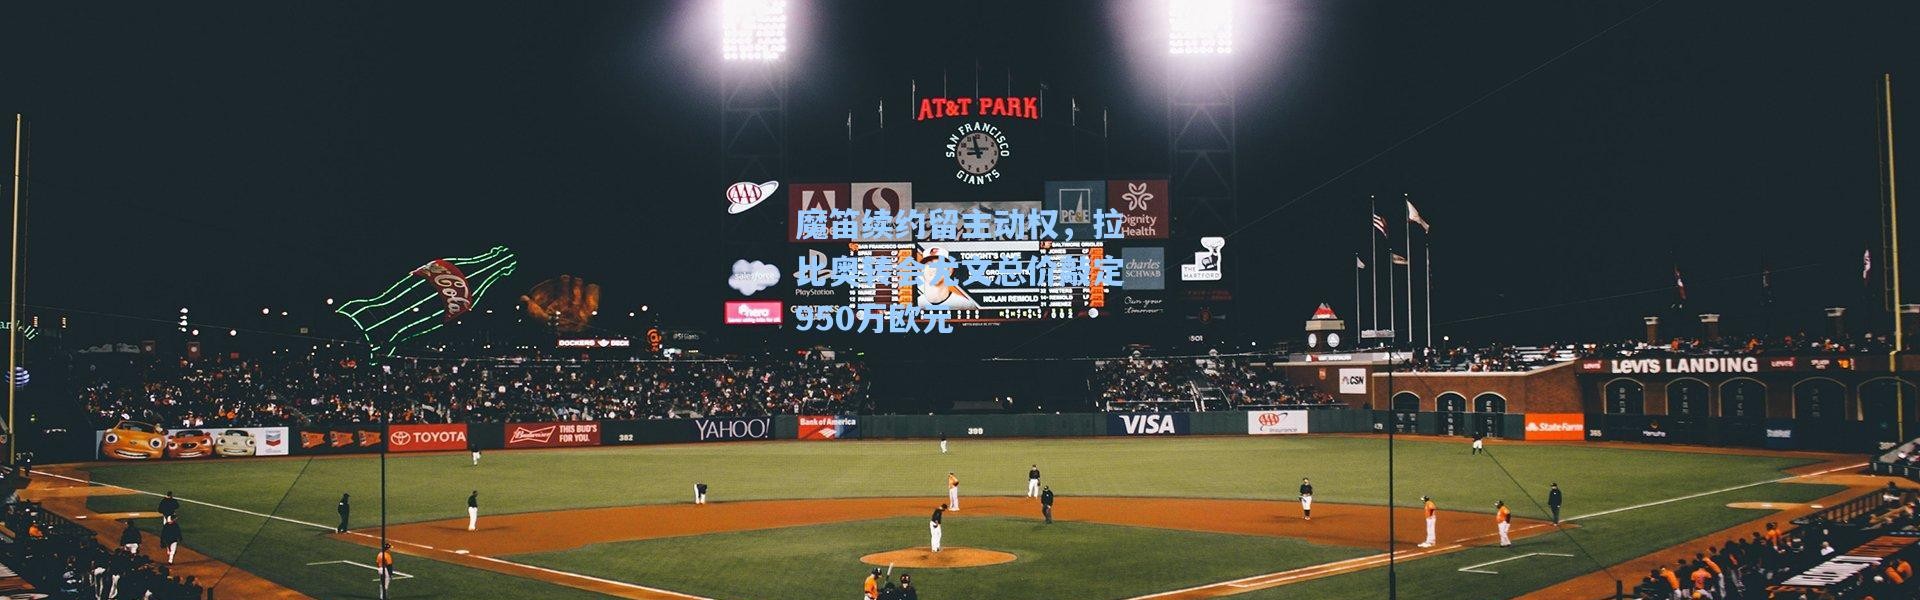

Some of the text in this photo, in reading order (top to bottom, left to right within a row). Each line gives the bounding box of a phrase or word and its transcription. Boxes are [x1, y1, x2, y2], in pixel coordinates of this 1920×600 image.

[917, 97, 1038, 120] AT&T PARK
[945, 121, 1010, 158] SAN FRANCISCO
[956, 169, 1000, 185] GIANTS
[1120, 214, 1157, 226] Dignity
[1121, 226, 1156, 236] Health
[1126, 259, 1160, 270] charles
[795, 288, 835, 297] PlayStation
[1666, 358, 1758, 373] LANDING
[560, 425, 575, 433] THIS
[695, 418, 770, 440] YAHOO!
[1119, 415, 1175, 434] VISA
[413, 431, 466, 443] TOYOTA
